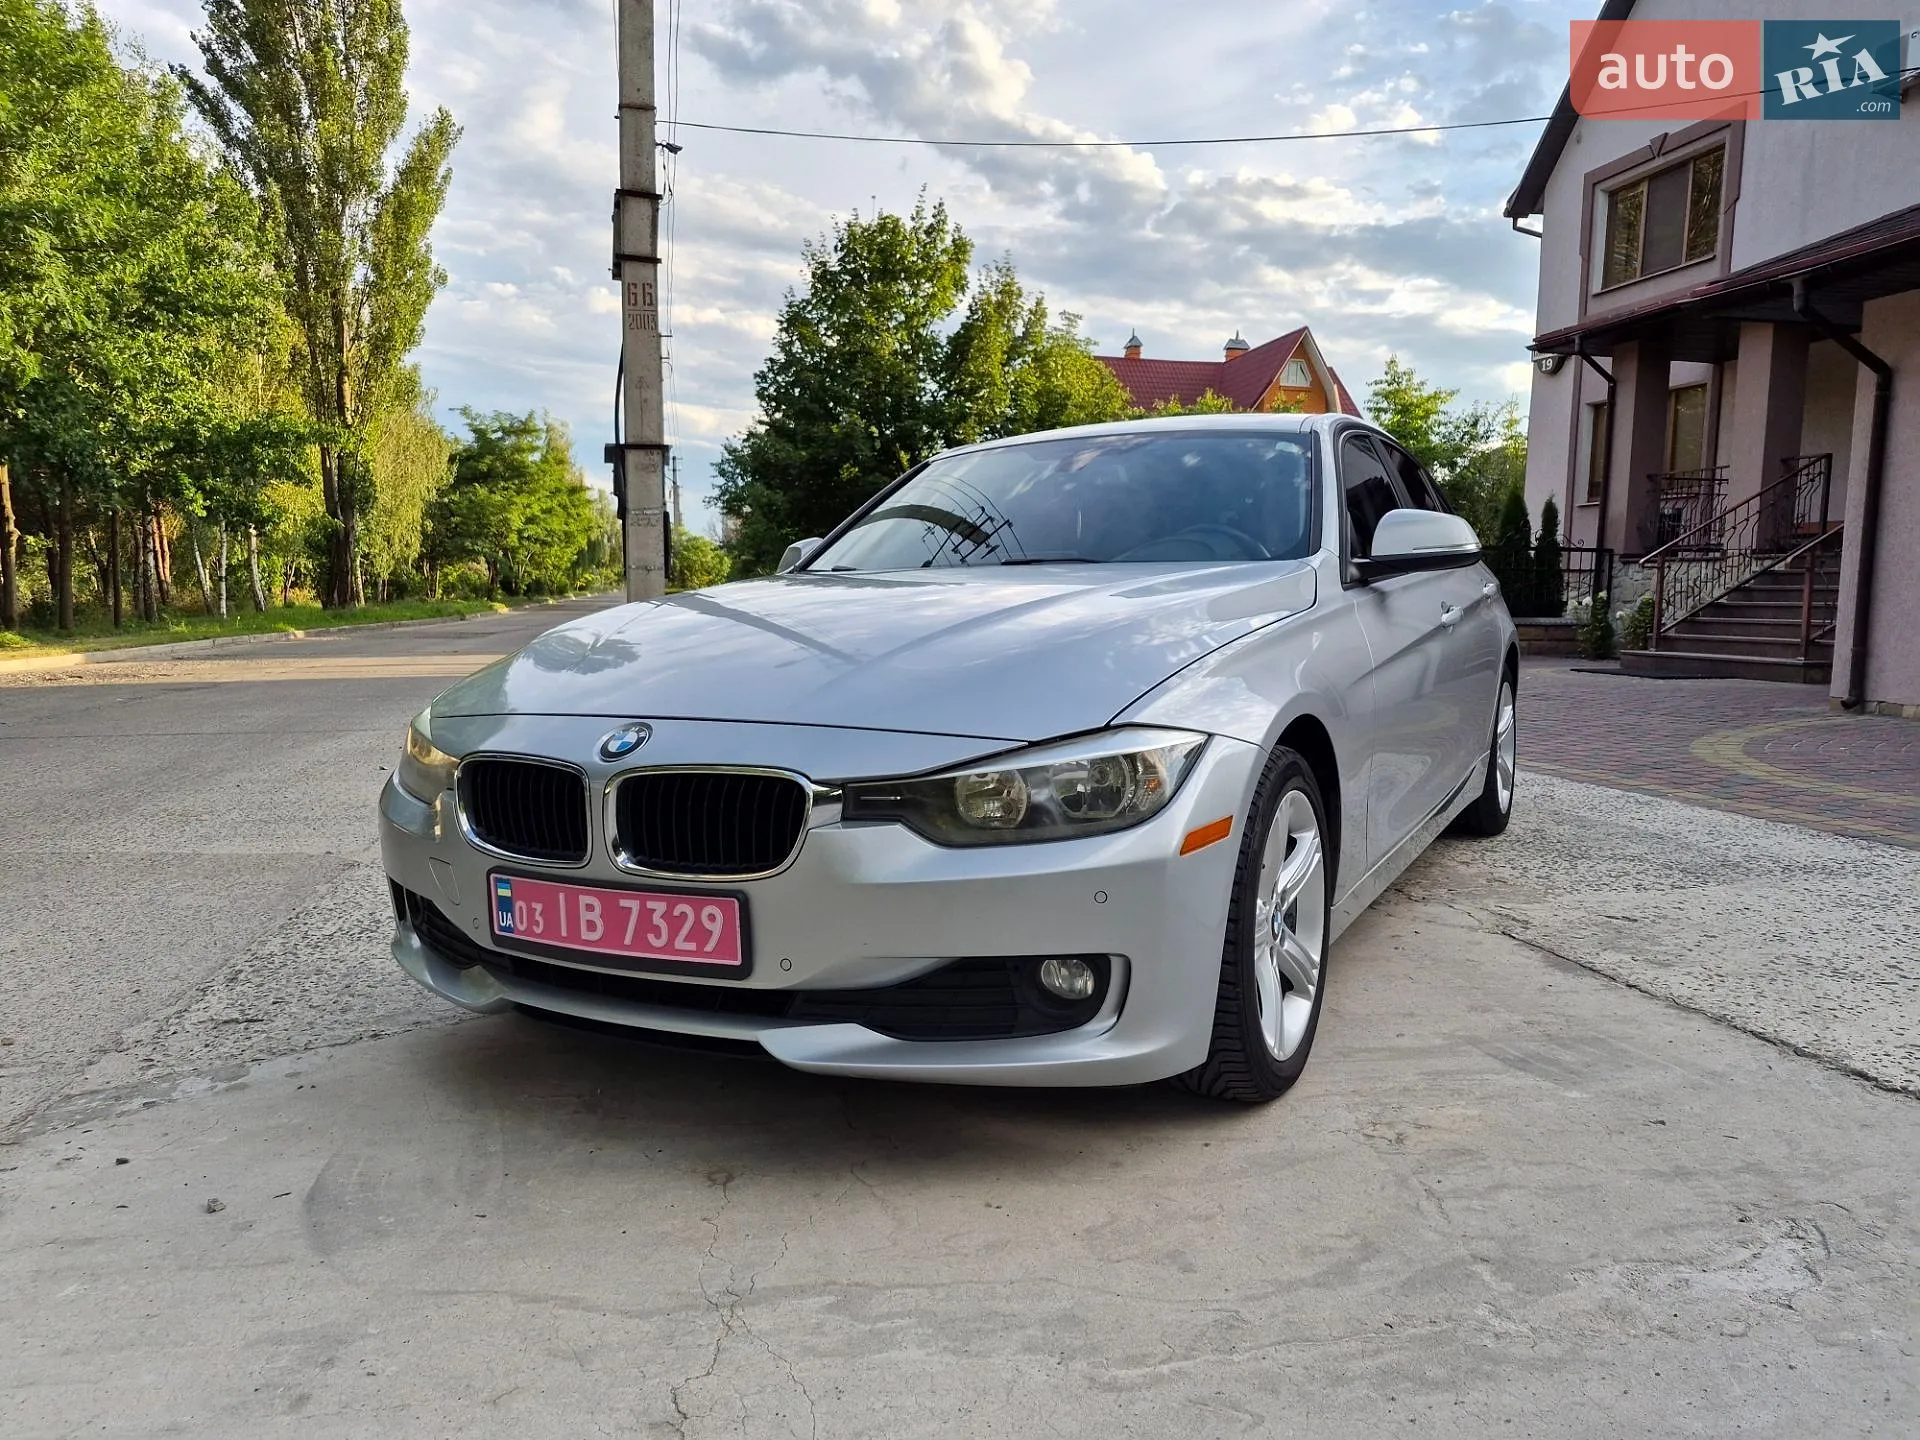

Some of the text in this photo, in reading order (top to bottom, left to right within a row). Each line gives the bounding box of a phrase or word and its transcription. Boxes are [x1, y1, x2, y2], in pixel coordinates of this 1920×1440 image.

[1542, 358, 1553, 371] 19
[499, 911, 514, 928] UA
[515, 892, 724, 952] 03 IB 7329
